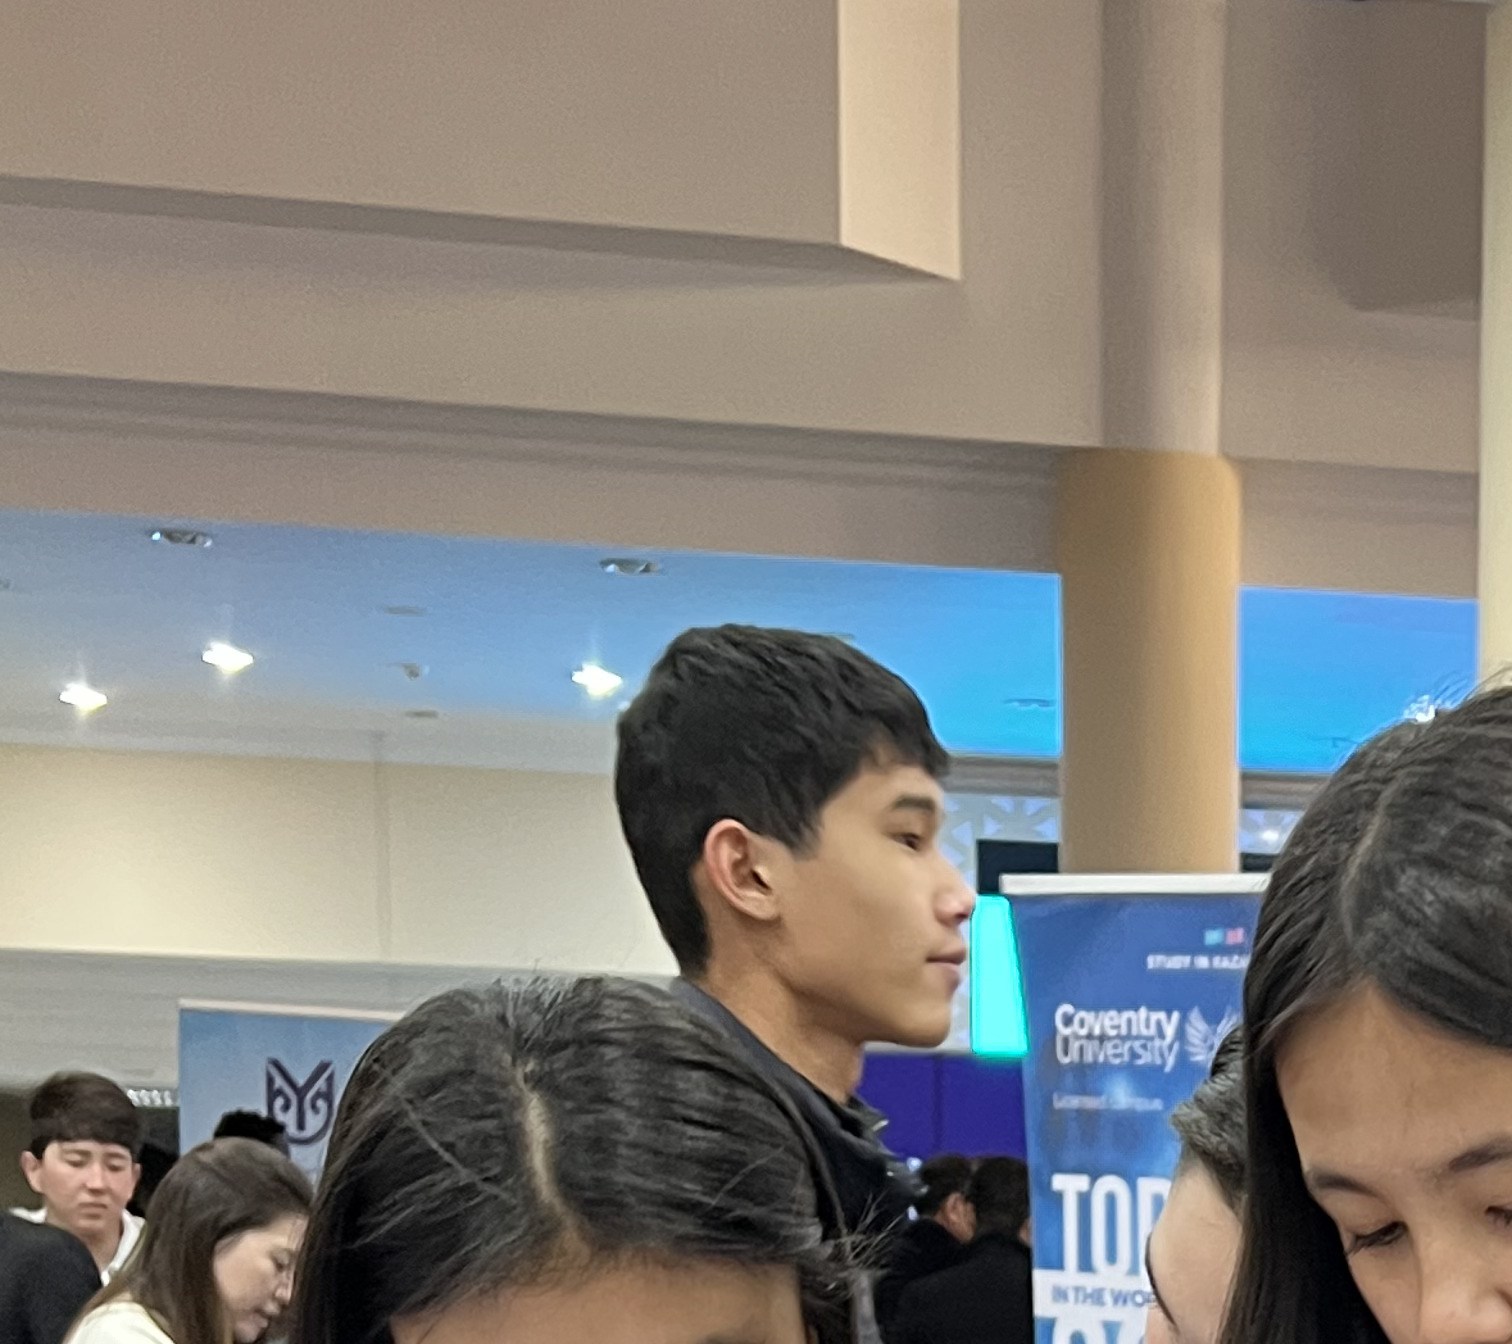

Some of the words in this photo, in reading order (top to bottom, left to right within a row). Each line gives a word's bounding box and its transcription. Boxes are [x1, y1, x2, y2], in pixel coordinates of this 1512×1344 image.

[1055, 1003, 1181, 1047] Coventry
[1055, 1033, 1180, 1073] University
[1051, 1284, 1070, 1304] IN
[1072, 1285, 1107, 1307] THE
